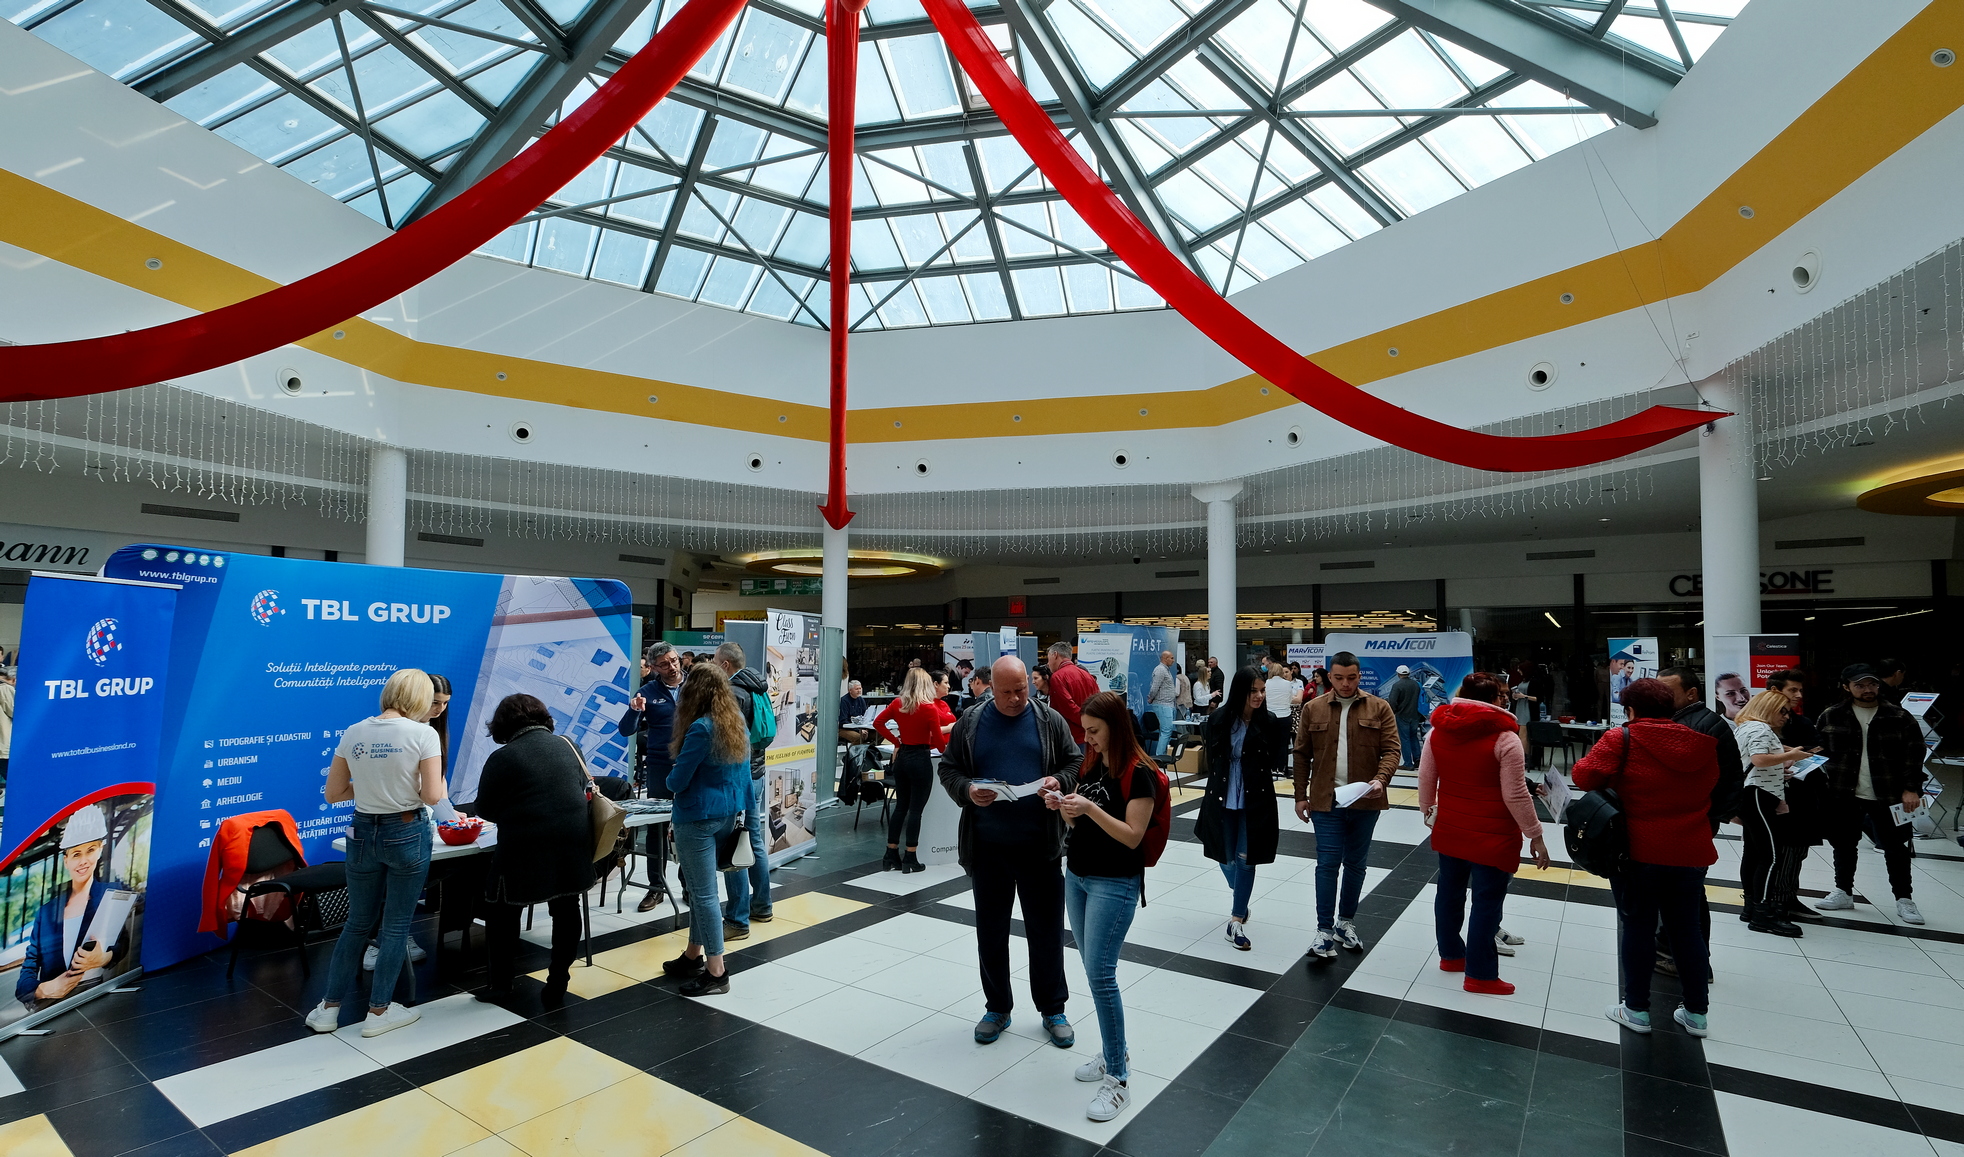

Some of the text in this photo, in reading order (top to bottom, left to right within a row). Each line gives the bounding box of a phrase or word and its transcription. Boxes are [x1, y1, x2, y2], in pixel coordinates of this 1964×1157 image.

[139, 569, 218, 584] www.tblgrup.ro
[1669, 570, 1835, 598] CESONE
[302, 598, 452, 624] TBL GRUP
[1132, 638, 1162, 652] FAIST
[1288, 646, 1325, 654] MARVICON
[1364, 637, 1437, 650] MARVICON
[265, 662, 398, 675] Soluții Inteligente pentru
[45, 677, 154, 700] TBL GRUP
[273, 678, 335, 689] Comunități
[219, 738, 265, 747] TOPOGRAFIE
[274, 732, 312, 743] CADASTRU
[51, 742, 137, 759] www.totalbusinessland.ro
[217, 755, 258, 767] URBANISM
[217, 776, 242, 787] MEDIU
[216, 792, 263, 807] ARHEOLOGIE
[331, 799, 356, 809] PRODU
[303, 816, 332, 828] LUCRĂRI
[333, 813, 355, 824] CONS
[931, 844, 958, 853] Compani
